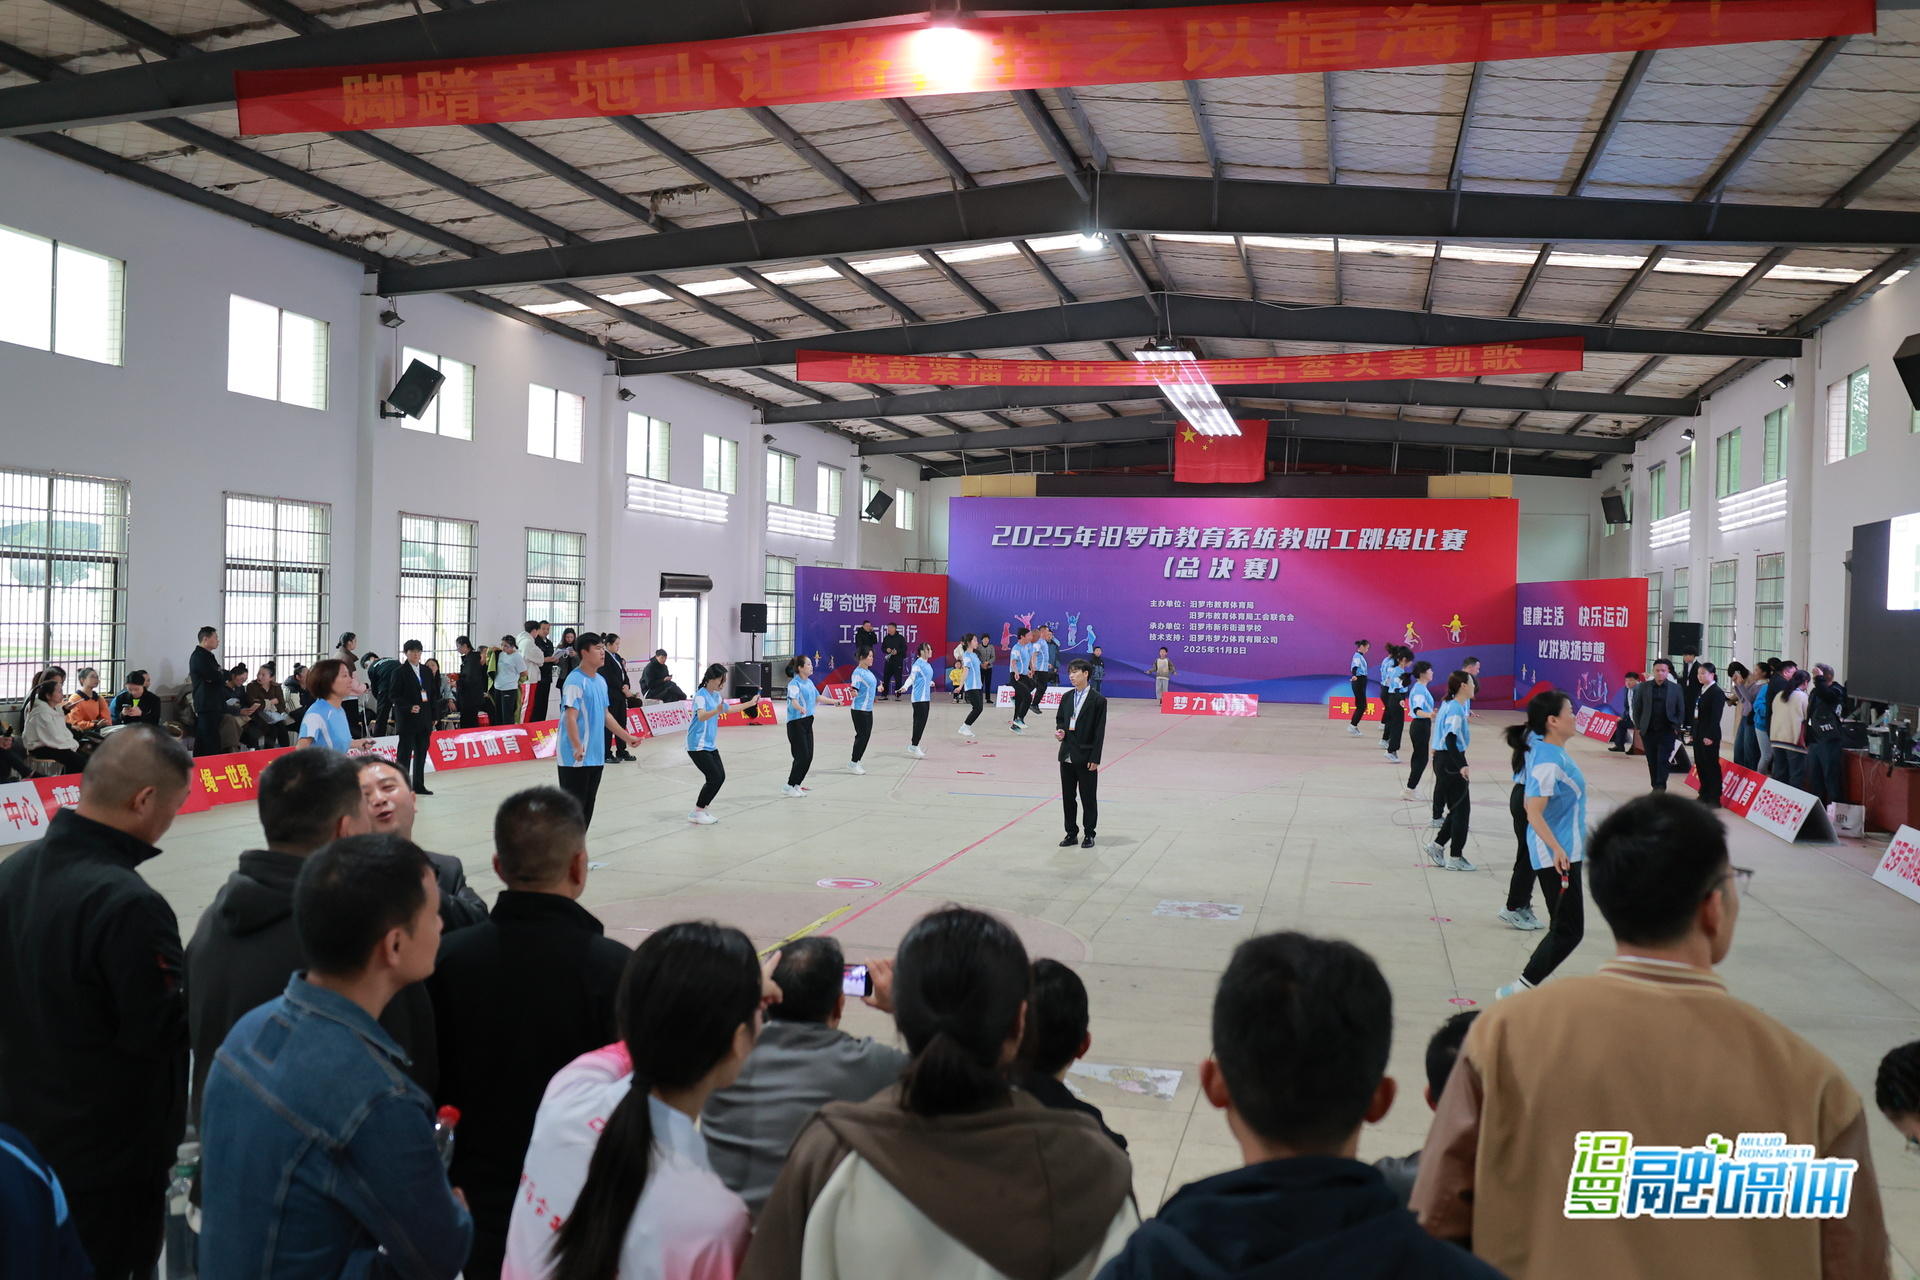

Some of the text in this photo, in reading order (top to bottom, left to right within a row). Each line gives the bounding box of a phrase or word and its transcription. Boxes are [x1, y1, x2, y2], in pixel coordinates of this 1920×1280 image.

[991, 525, 1468, 551] 2025年汨罗市教育系统教职工跳绳比赛
[1189, 611, 1296, 622] 汨罗市教育体育局工会联合会
[1523, 606, 1630, 627] 健康生活 快乐运动
[1183, 645, 1248, 655] 2025年11月8日
[436, 733, 521, 762] 梦力体育
[0, 796, 39, 830] 中心
